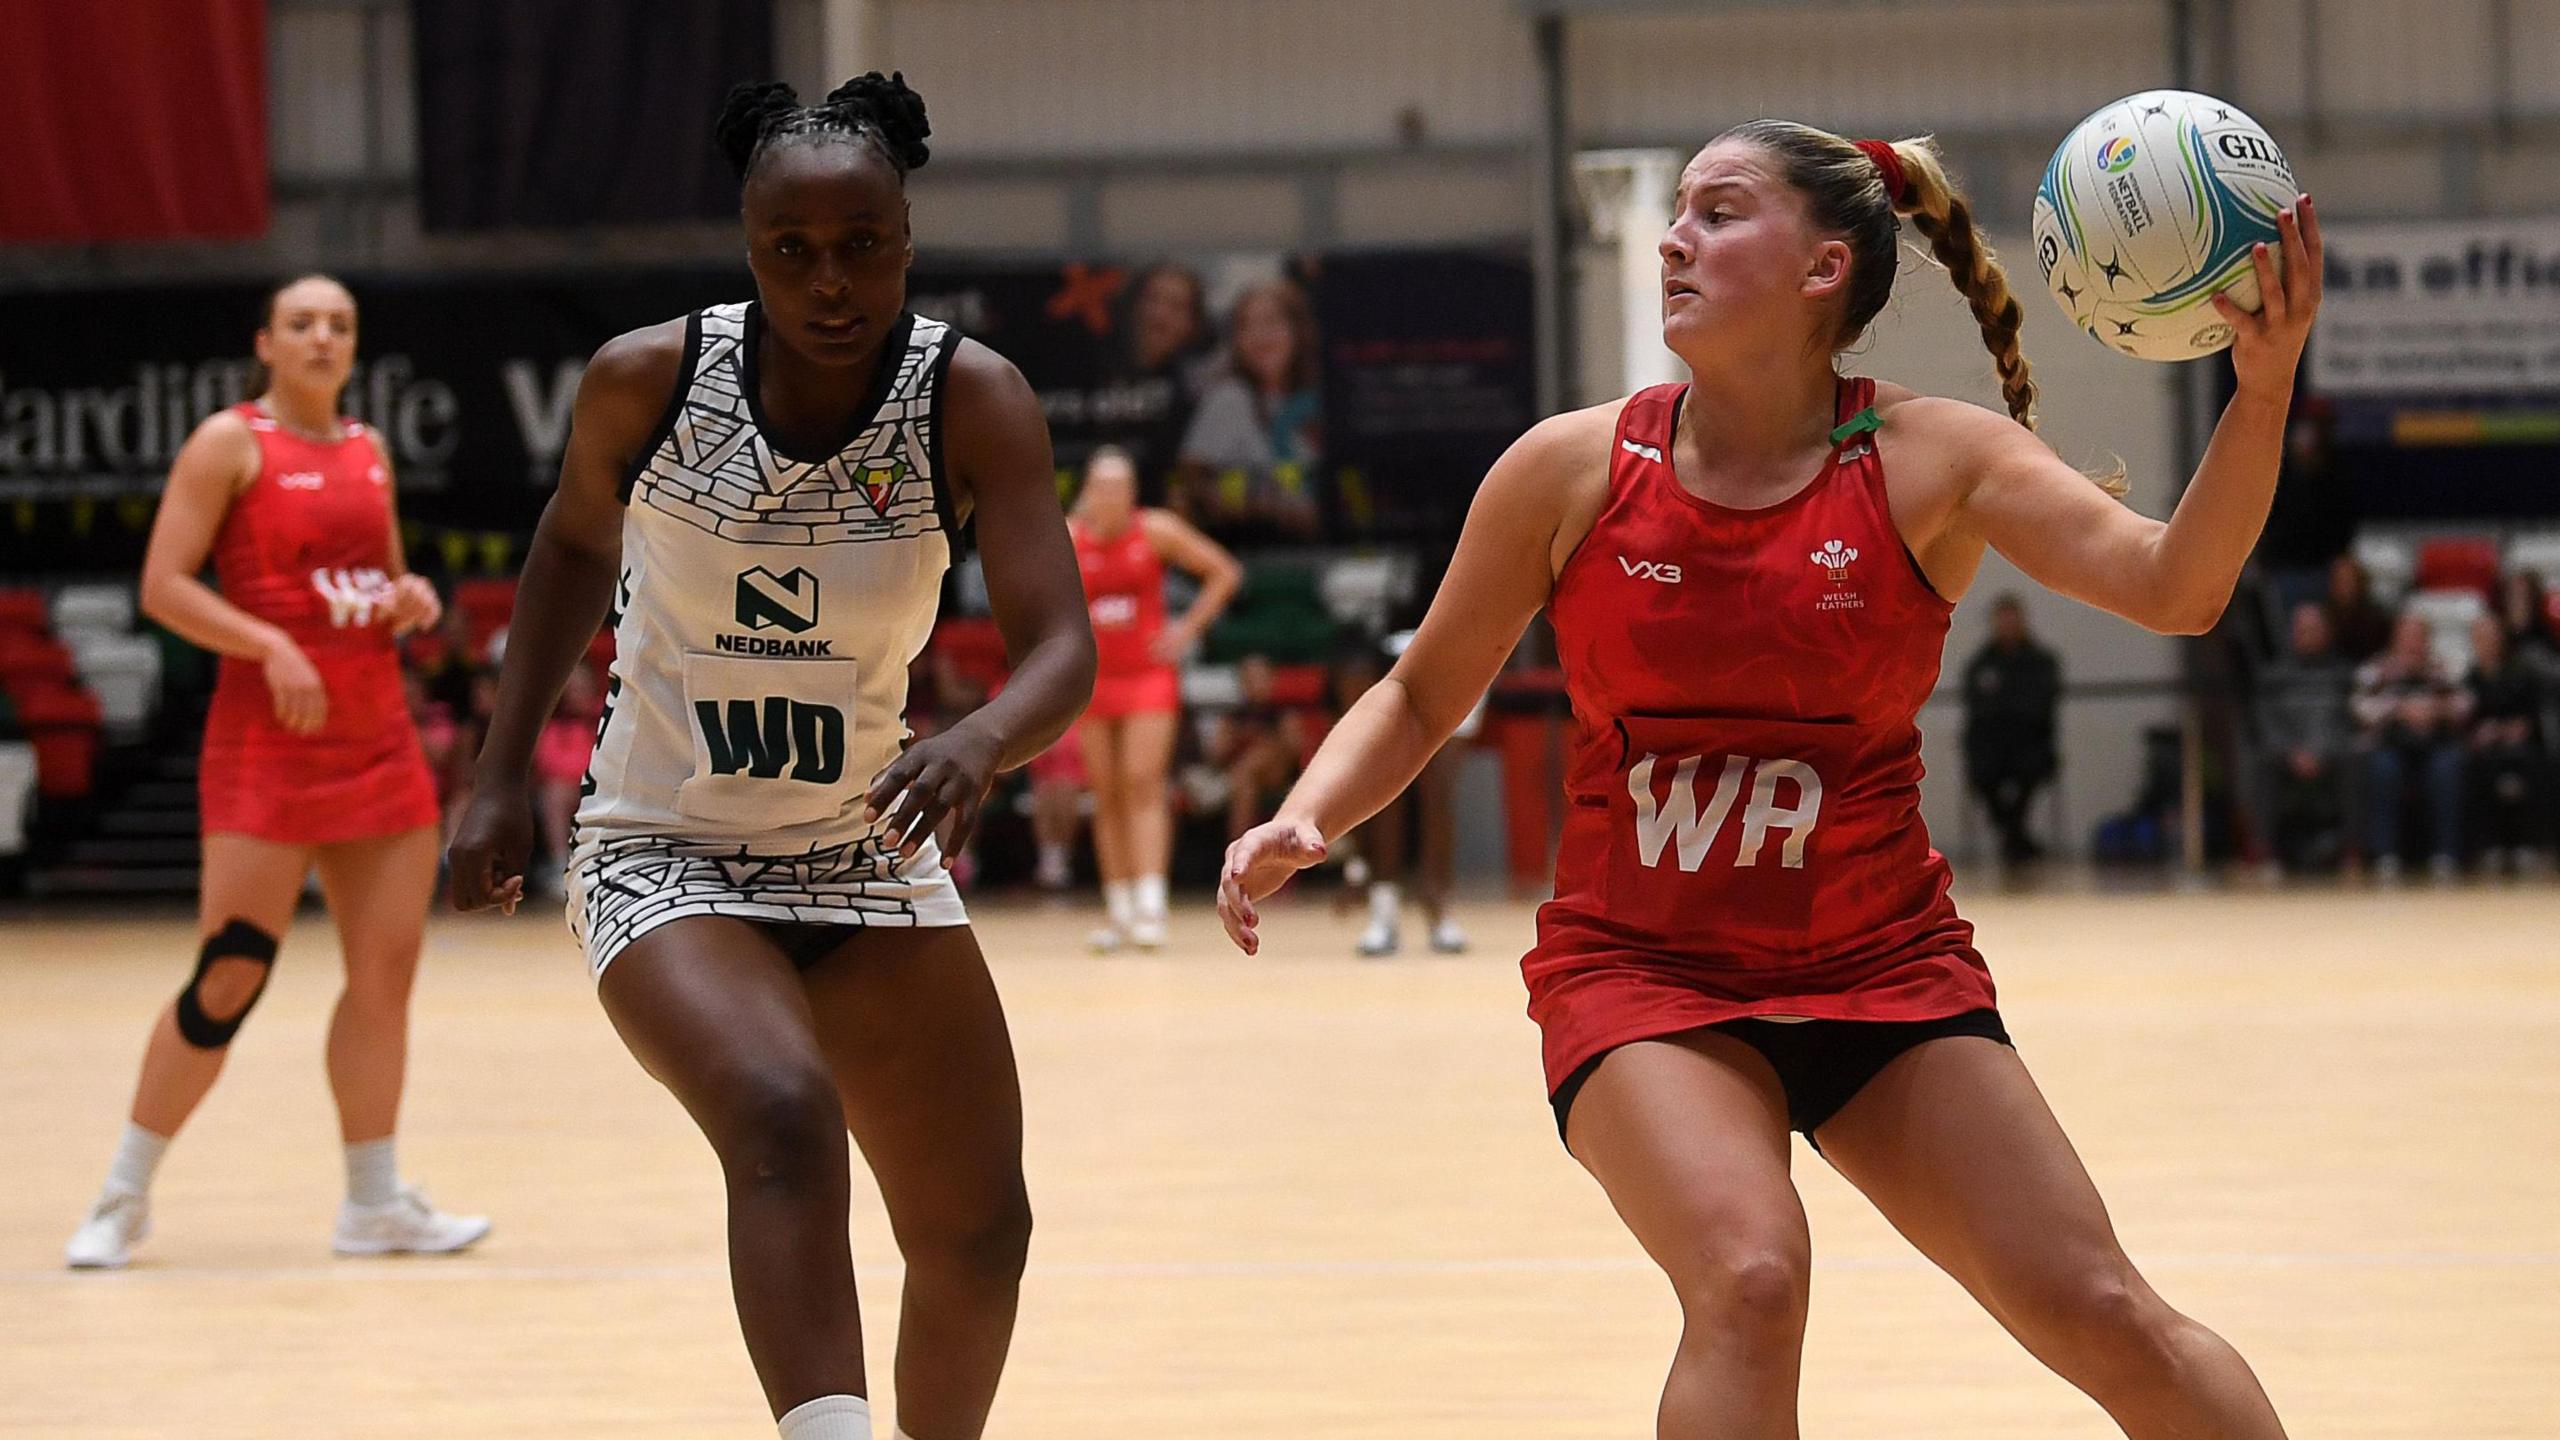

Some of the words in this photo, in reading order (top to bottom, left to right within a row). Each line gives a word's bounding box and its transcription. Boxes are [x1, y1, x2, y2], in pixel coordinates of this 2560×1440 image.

[2107, 180, 2135, 238] FEDERATION
[2115, 174, 2147, 234] NETBALL
[1617, 555, 1683, 584] VX3
[1815, 600, 1865, 611] FEATHERS
[1822, 592, 1858, 602] WELSH
[715, 633, 834, 657] NEDBANK
[694, 696, 845, 785] WD
[1627, 752, 1823, 873] WA
